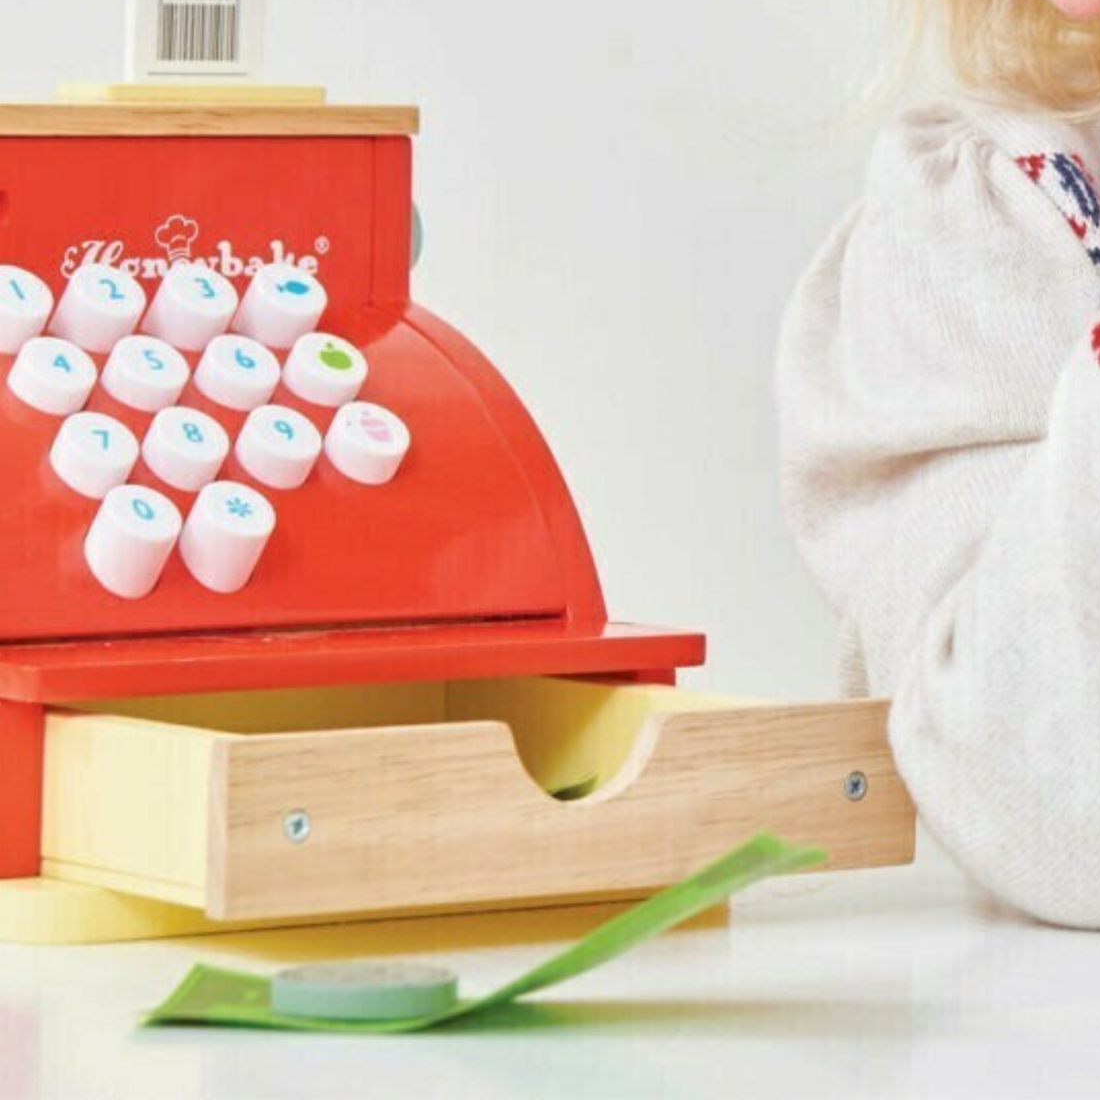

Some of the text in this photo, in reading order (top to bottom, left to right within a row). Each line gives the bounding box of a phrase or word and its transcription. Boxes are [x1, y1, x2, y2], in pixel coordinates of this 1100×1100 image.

[60, 239, 319, 280] Honybake
[9, 277, 216, 301] 1 2 3
[52, 347, 257, 374] 4 5 6
[91, 419, 296, 450] 7 8 9
[131, 498, 155, 521] 0
